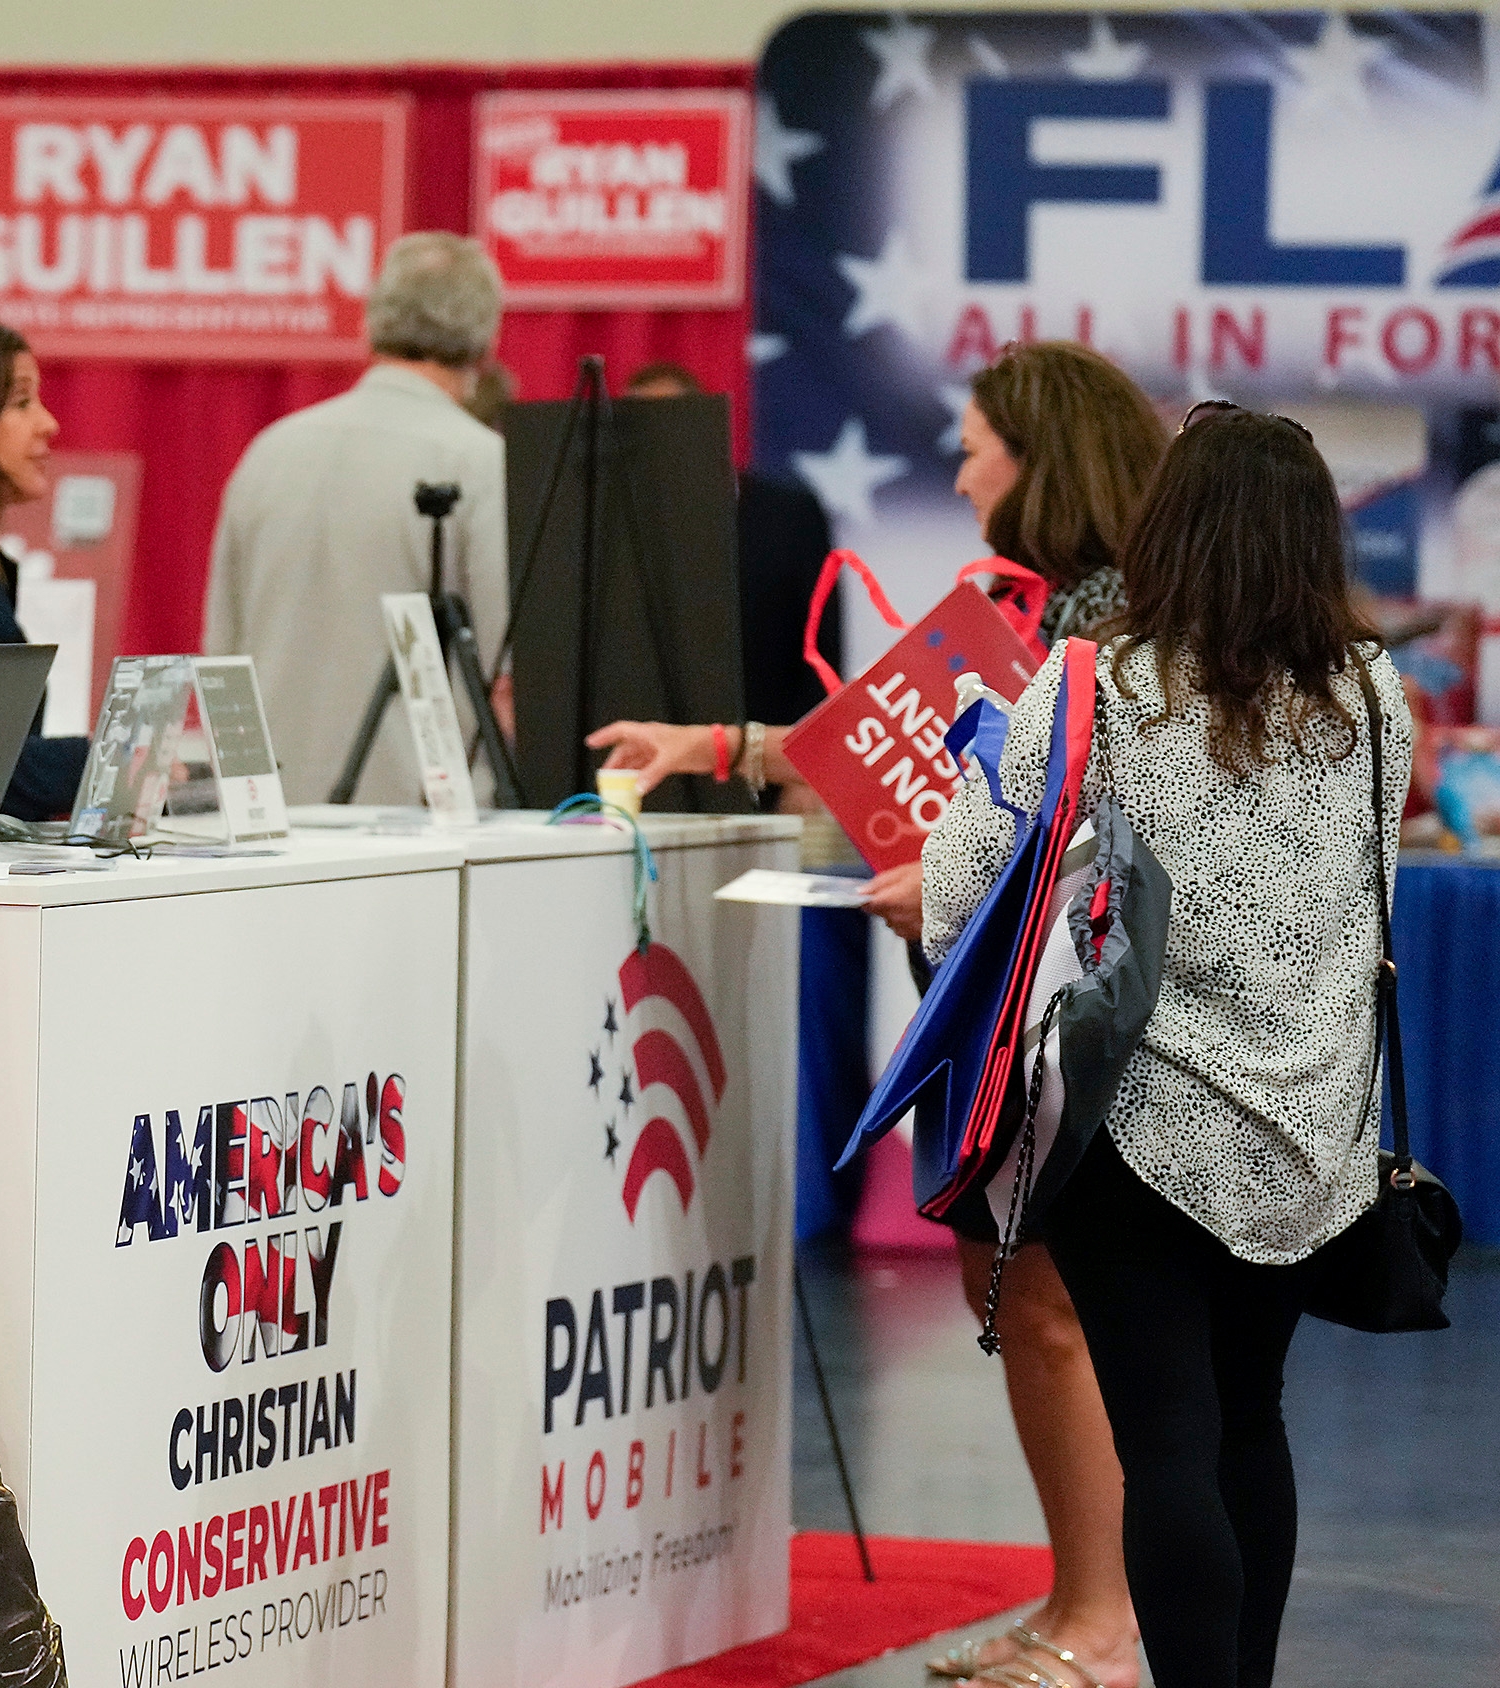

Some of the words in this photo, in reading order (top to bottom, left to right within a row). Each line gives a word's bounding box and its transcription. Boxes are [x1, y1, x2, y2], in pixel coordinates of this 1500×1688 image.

[14, 123, 299, 201] RYAN
[489, 190, 724, 234] GUILLEN
[533, 145, 686, 186] RYAN
[964, 78, 1500, 286] FL
[1170, 302, 1268, 374] IN
[844, 716, 896, 768] IS
[115, 1071, 406, 1248] AMERICA'S
[199, 1220, 343, 1373] ONLY
[543, 1255, 756, 1434] PATRIOT
[168, 1369, 357, 1491] CHRISTIAN
[540, 1411, 745, 1535] MOBILE
[120, 1468, 390, 1622] CONSERVATIVE
[544, 1548, 645, 1613] Mobilizing
[119, 1609, 253, 1688] WIRELESS
[260, 1567, 389, 1653] PROVIDER
